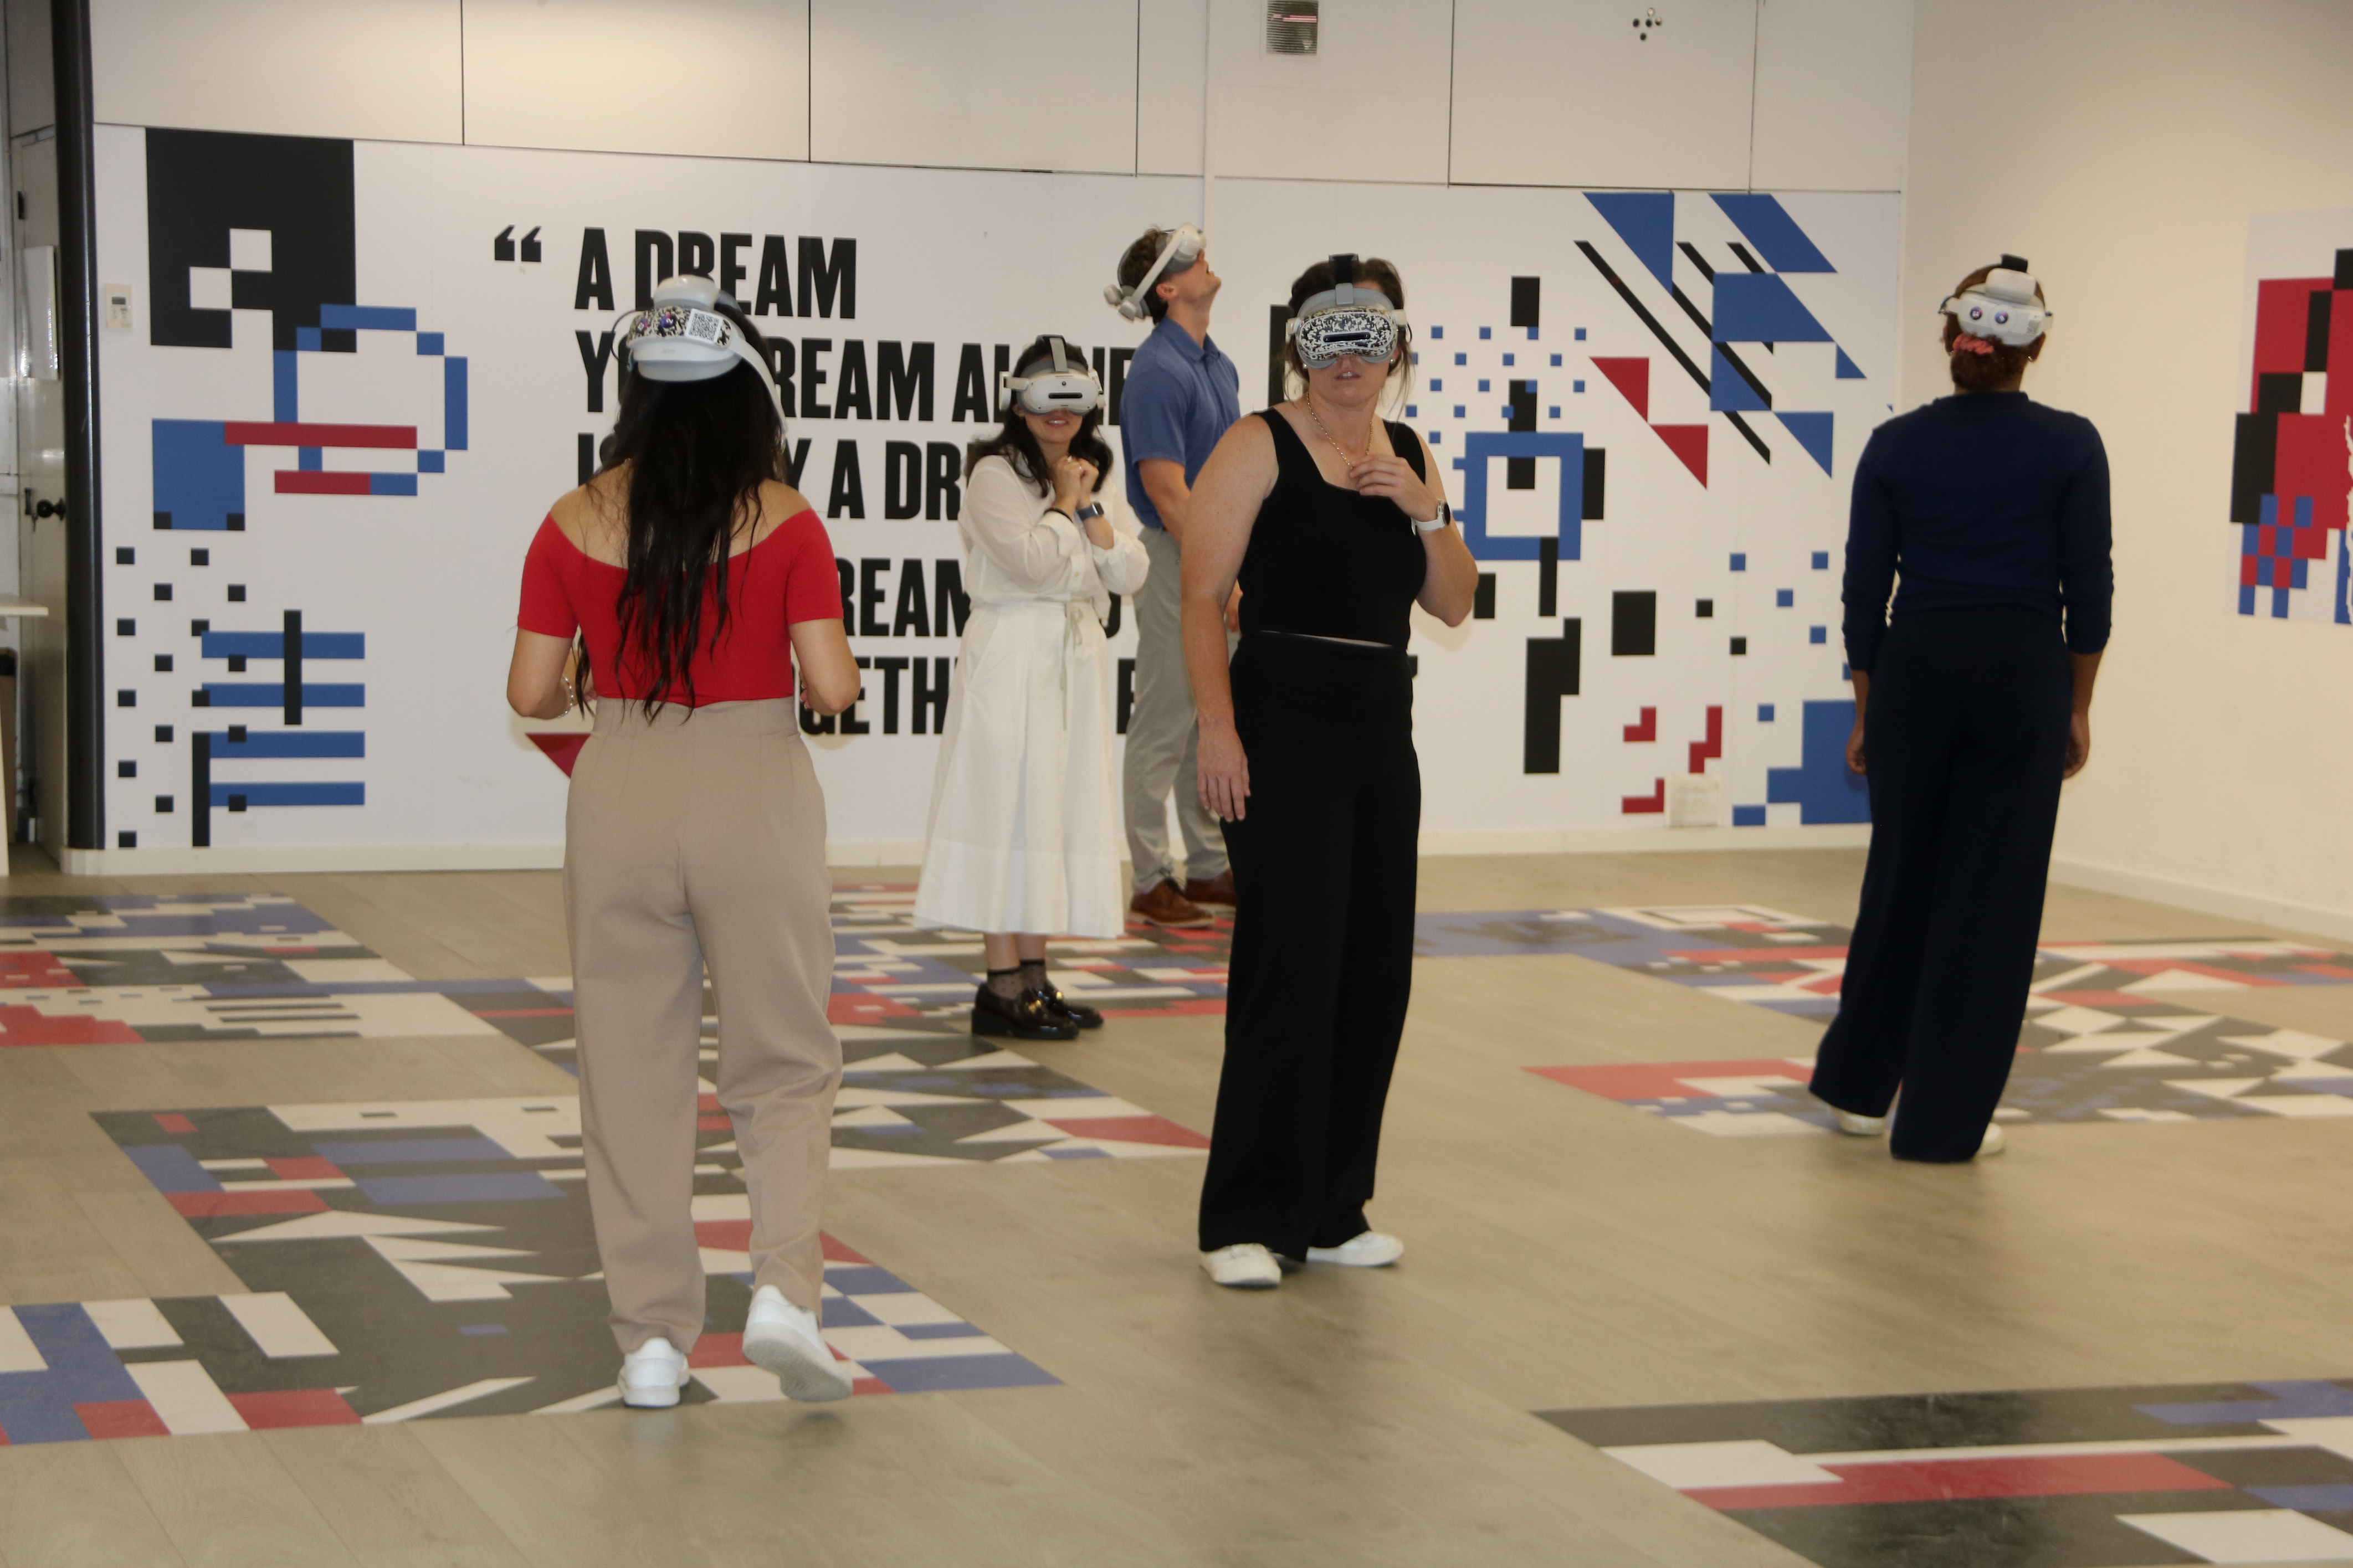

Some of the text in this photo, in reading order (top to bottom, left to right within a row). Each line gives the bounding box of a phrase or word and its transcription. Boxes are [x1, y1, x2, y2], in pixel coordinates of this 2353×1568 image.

[575, 227, 614, 310] A
[762, 336, 935, 422] REAM
[827, 439, 865, 519] A
